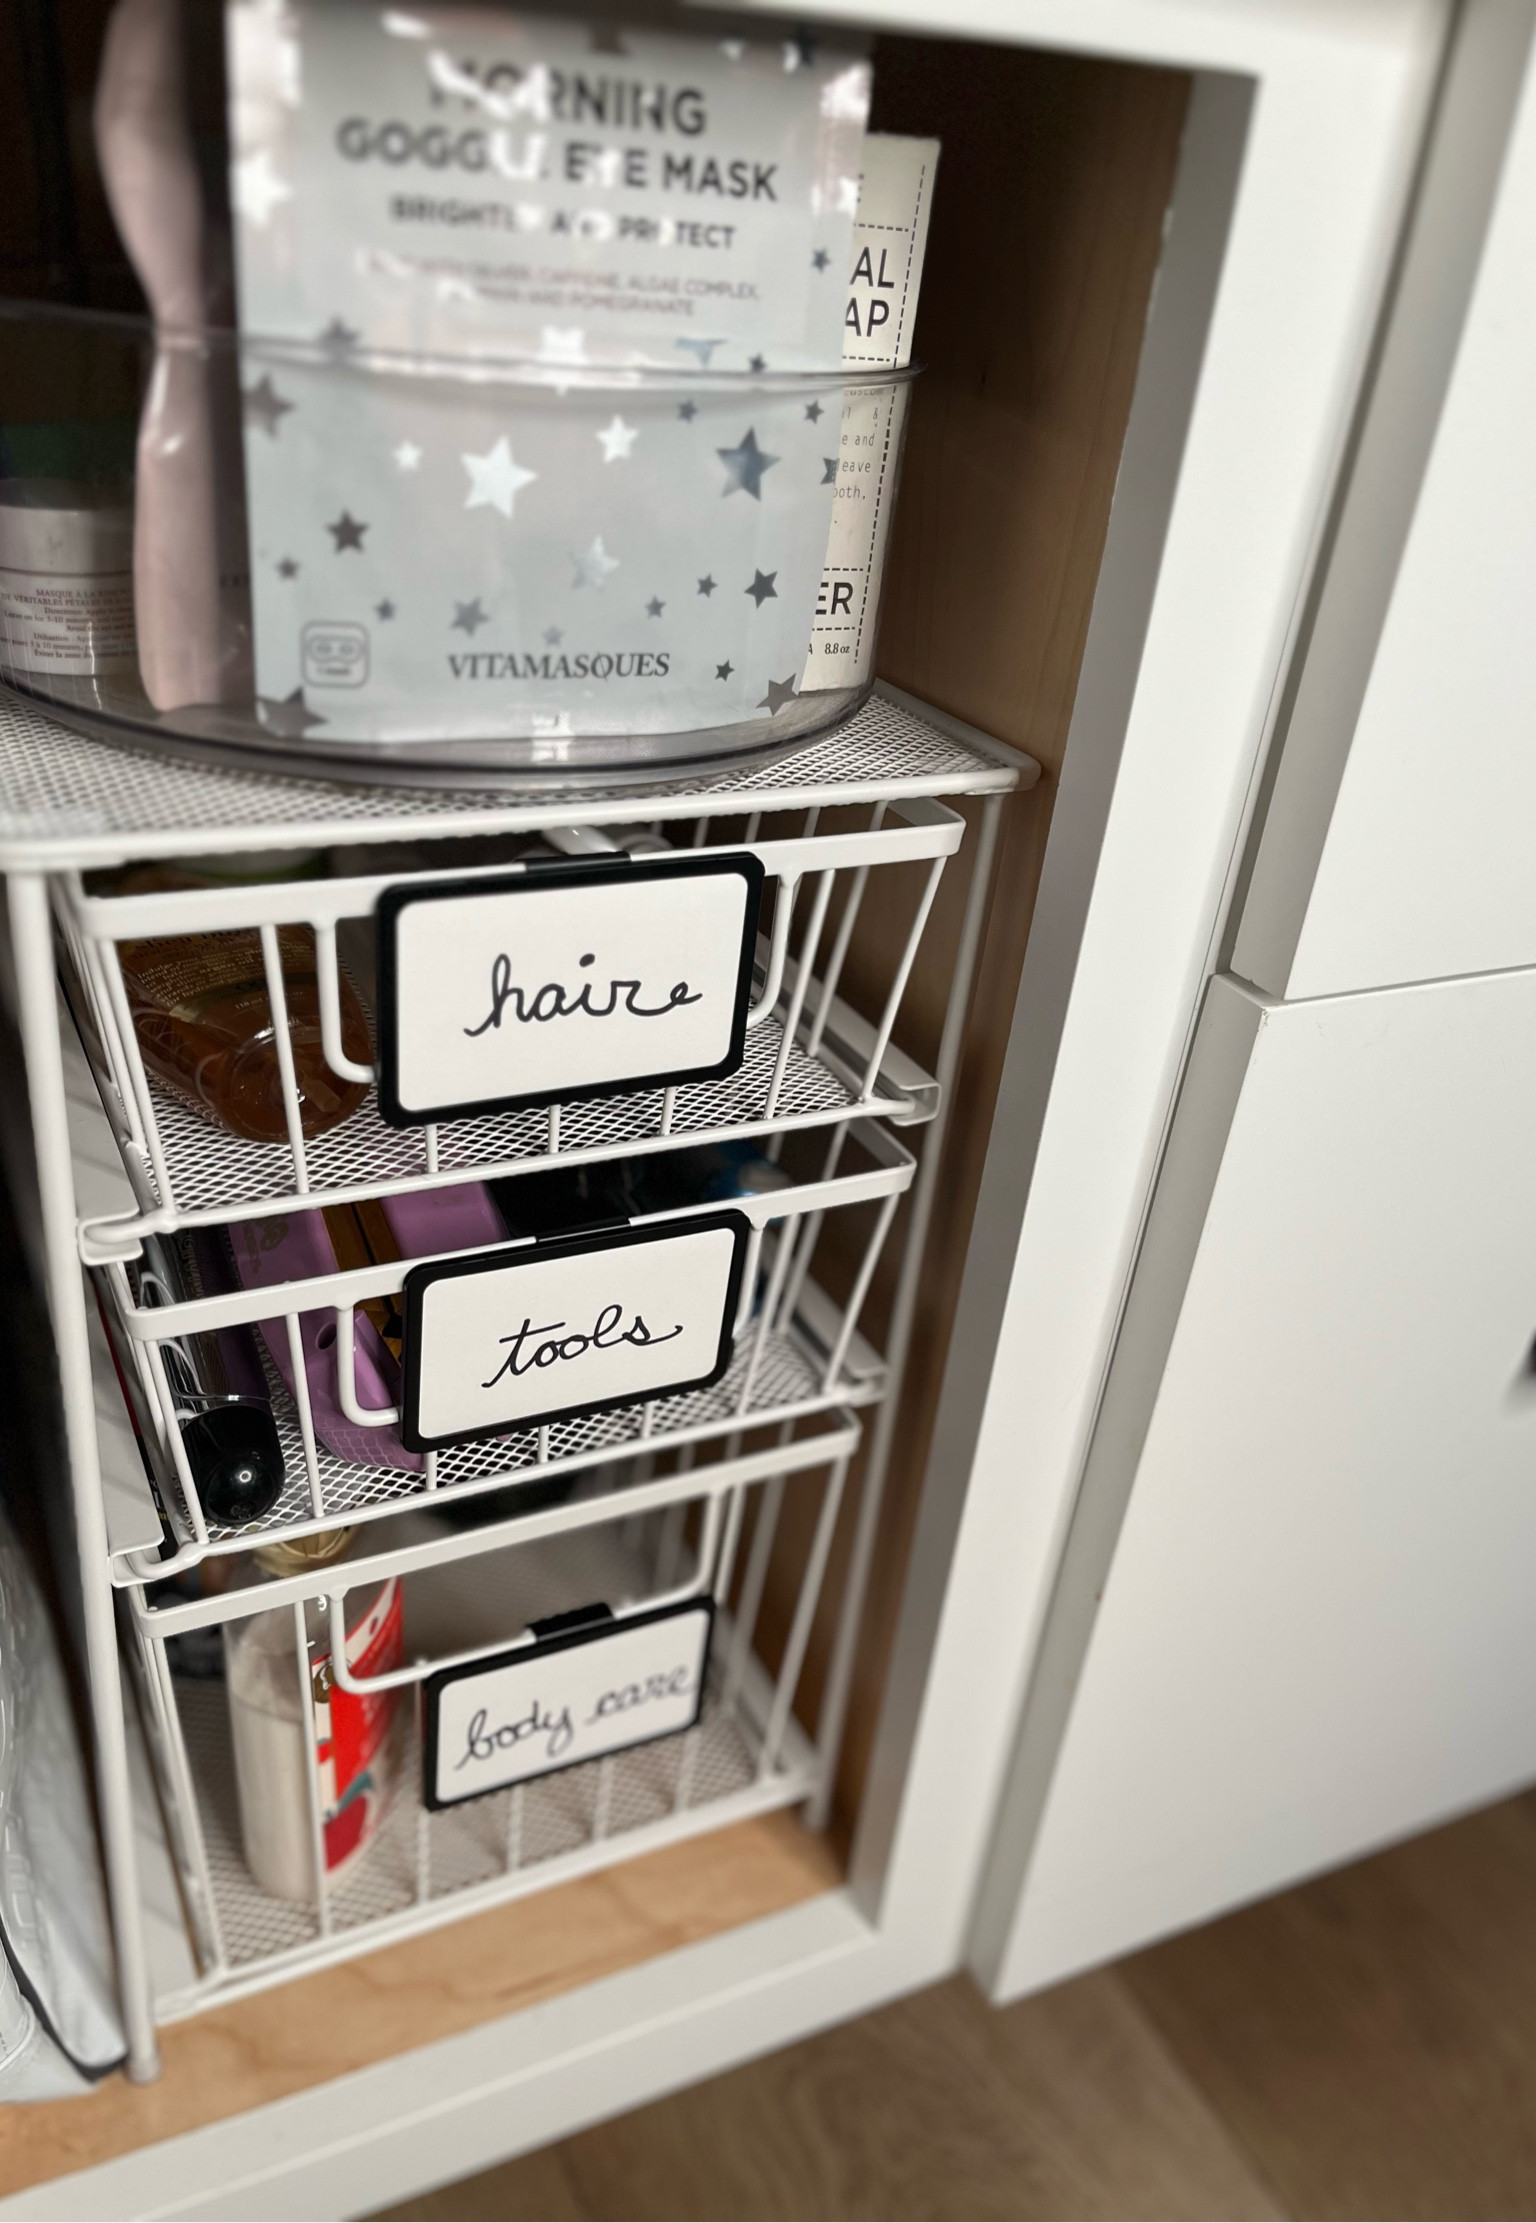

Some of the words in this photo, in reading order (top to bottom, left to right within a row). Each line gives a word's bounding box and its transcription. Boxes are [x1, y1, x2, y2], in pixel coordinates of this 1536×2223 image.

[662, 152, 779, 201] MASK
[618, 213, 736, 249] PRTECT
[854, 433, 876, 447] and
[36, 589, 73, 599] MASQUE
[824, 642, 839, 655] 8.8
[447, 652, 670, 681] VITAMASQUES
[481, 1304, 683, 1388] tools
[453, 1699, 575, 1772] body
[582, 1664, 697, 1726] care
